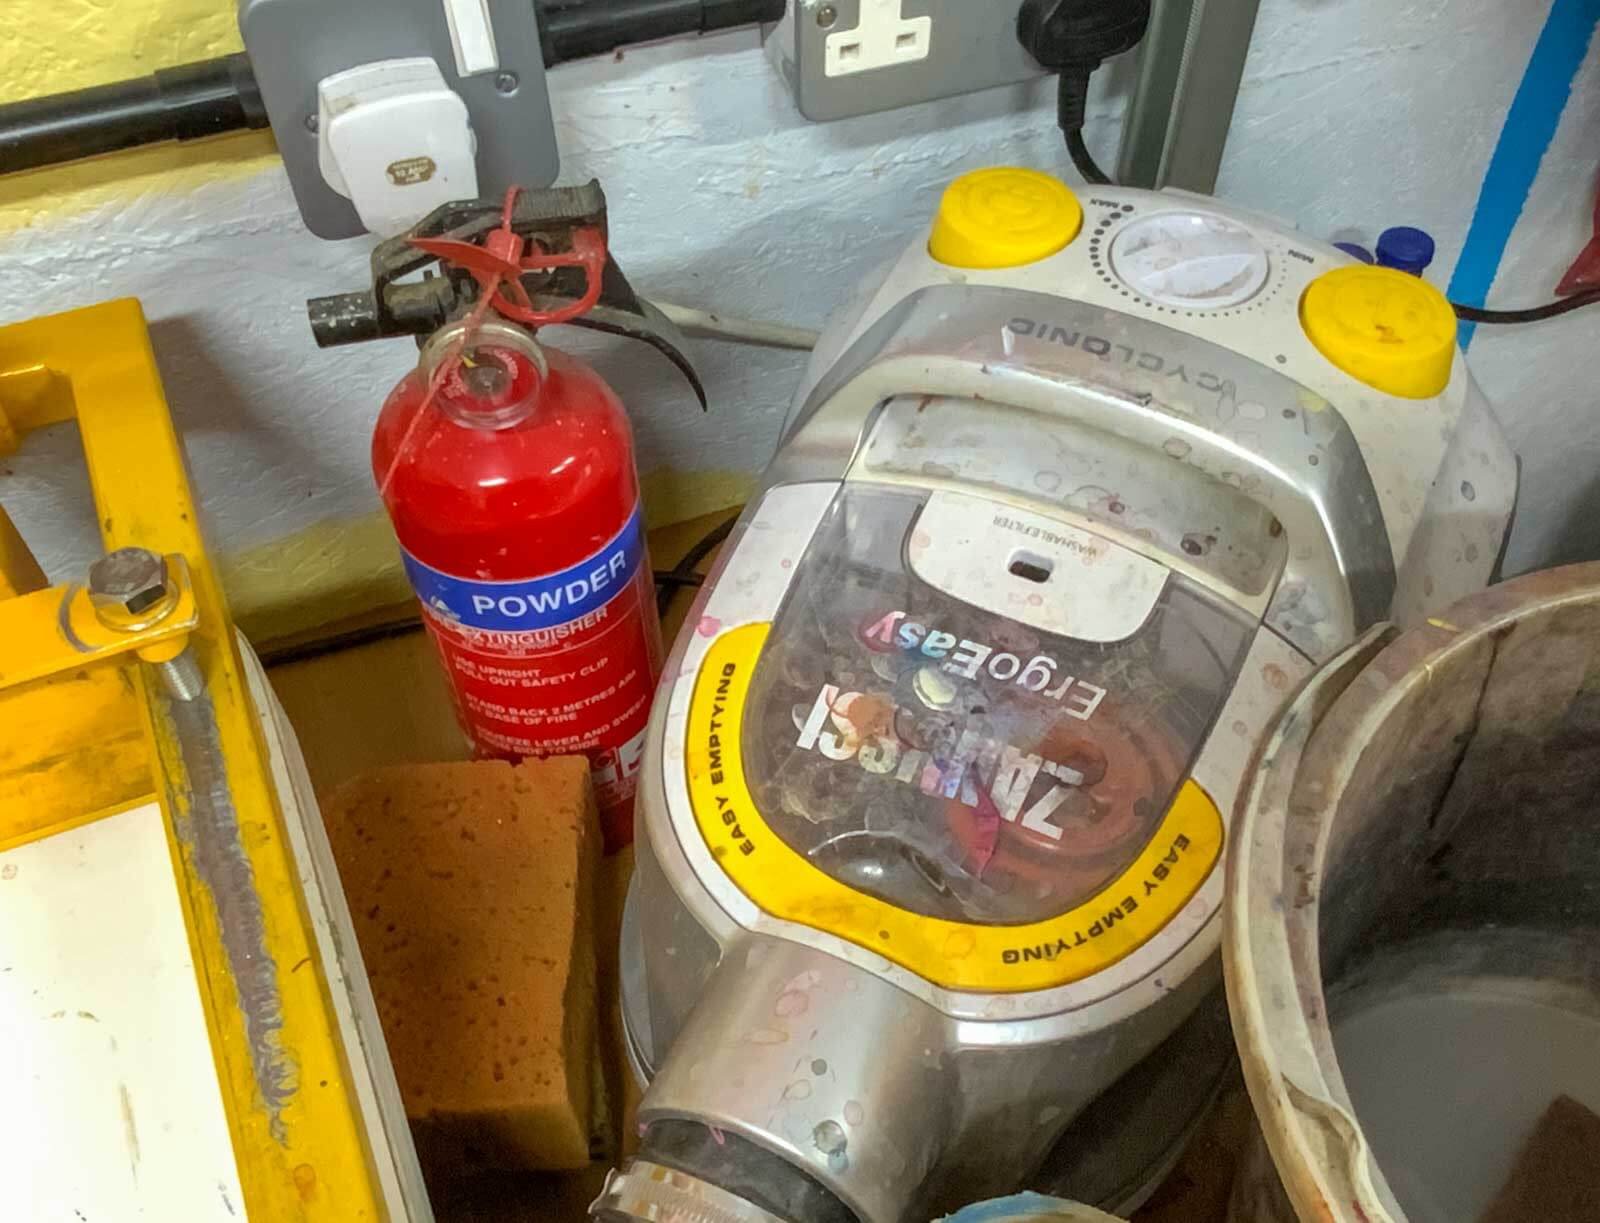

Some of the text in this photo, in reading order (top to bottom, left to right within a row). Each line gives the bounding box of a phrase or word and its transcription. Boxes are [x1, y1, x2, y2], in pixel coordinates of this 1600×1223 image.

[1006, 317, 1224, 392] CYCLONIC
[472, 550, 627, 617] POWDER
[479, 664, 541, 678] UPRIGHT
[489, 675, 517, 687] OUT
[522, 671, 576, 688] SAFETY
[580, 656, 609, 676] CLIP
[864, 611, 1107, 720] ErgoEasy
[485, 708, 521, 725] BASE
[523, 716, 542, 726] OF
[546, 712, 577, 724] FIRE
[508, 706, 549, 718] BACK
[563, 686, 616, 714] METRES
[534, 735, 580, 748] LEVER
[583, 724, 611, 740] AND
[568, 736, 600, 751] SIDE
[708, 662, 755, 856] EASY EMPTYING
[1002, 833, 1191, 964] EASY EMPTYING
